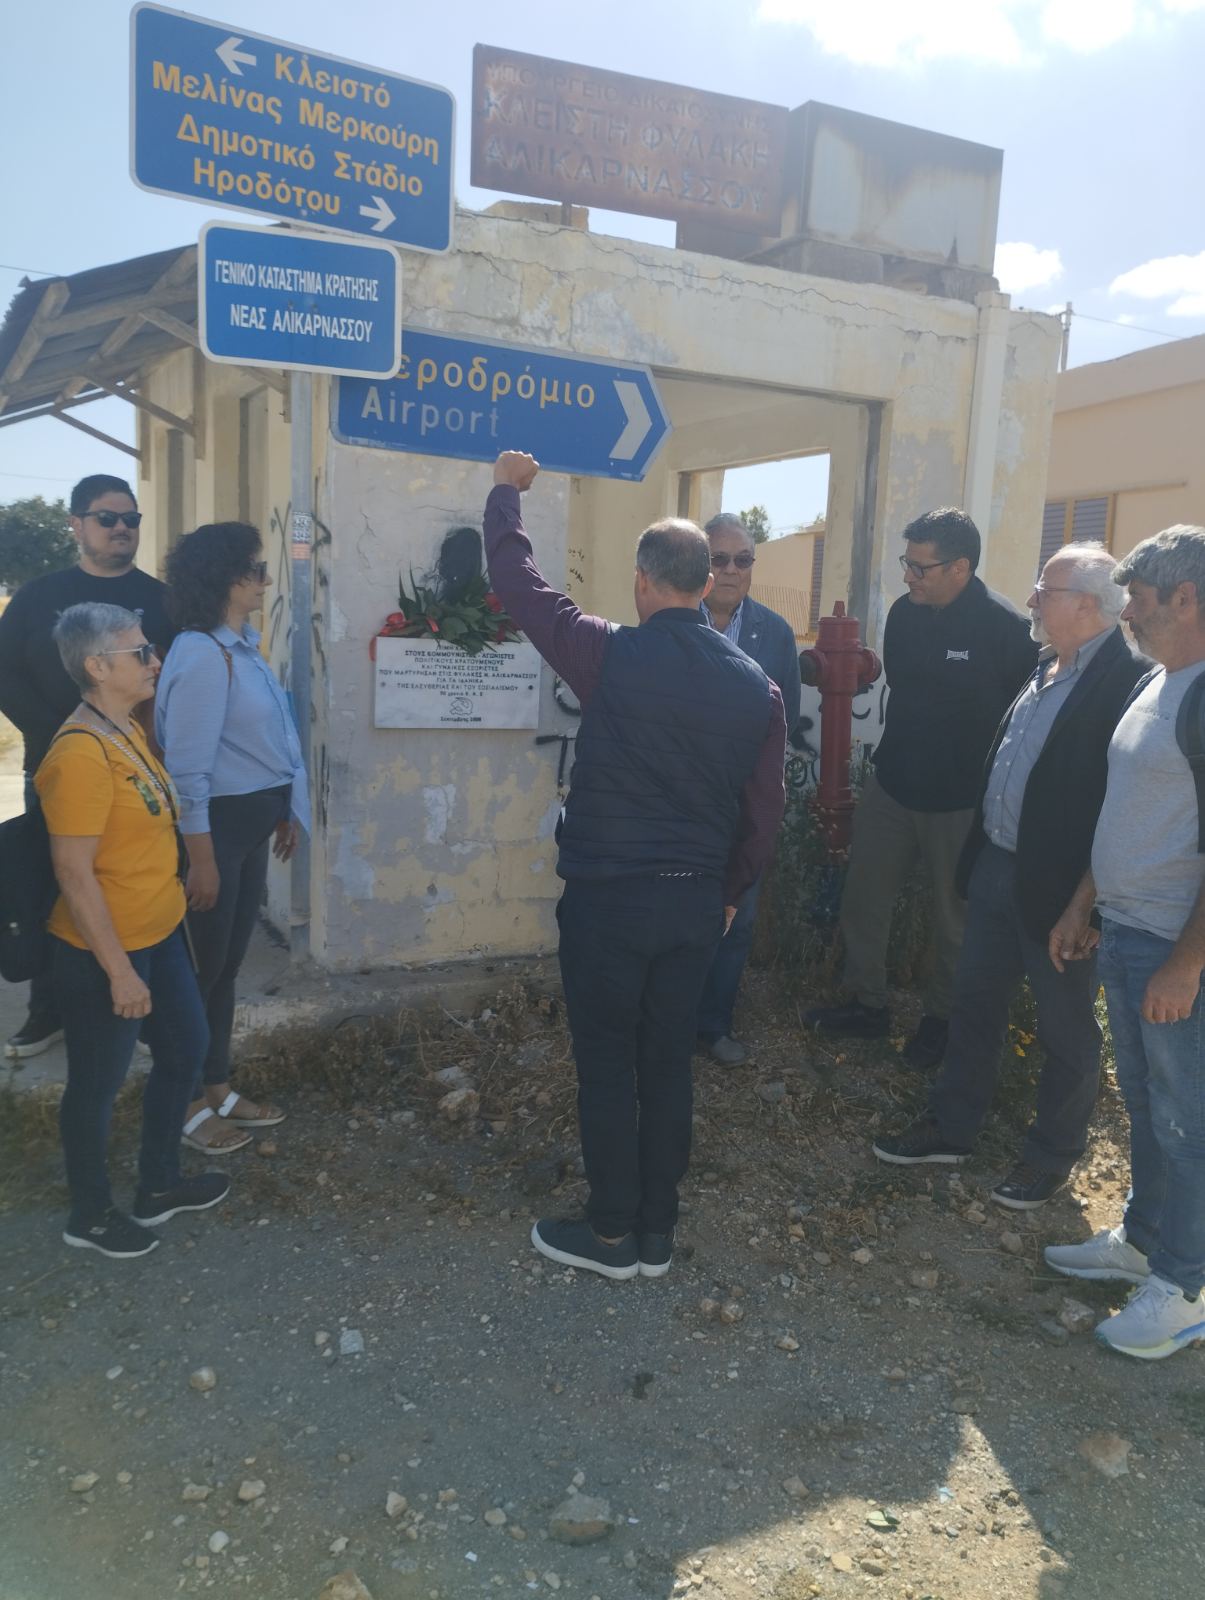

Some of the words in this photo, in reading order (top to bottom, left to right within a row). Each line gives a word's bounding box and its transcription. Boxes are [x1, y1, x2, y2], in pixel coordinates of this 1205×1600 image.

[275, 53, 391, 109] Κλειστό
[152, 60, 283, 125] Μελίνας
[299, 98, 440, 166] Μερκούρη
[176, 112, 316, 170] Δημοτικό
[333, 151, 423, 197] Στάδιο
[193, 157, 341, 216] Ηροδότου
[215, 259, 256, 287] ΓΕΝΙΚΟ
[258, 265, 323, 295] ΚΑΤΑΣΤΗΜΑ
[325, 273, 379, 302] ΚΡΑΤΗΣΗΣ
[230, 303, 267, 330] ΝΕΑΣ
[272, 309, 373, 343] ΑΛΙΚΑΡΝΑΣΣΟΥ
[395, 353, 596, 409] εροδρόμιο
[361, 385, 500, 438] Airport
